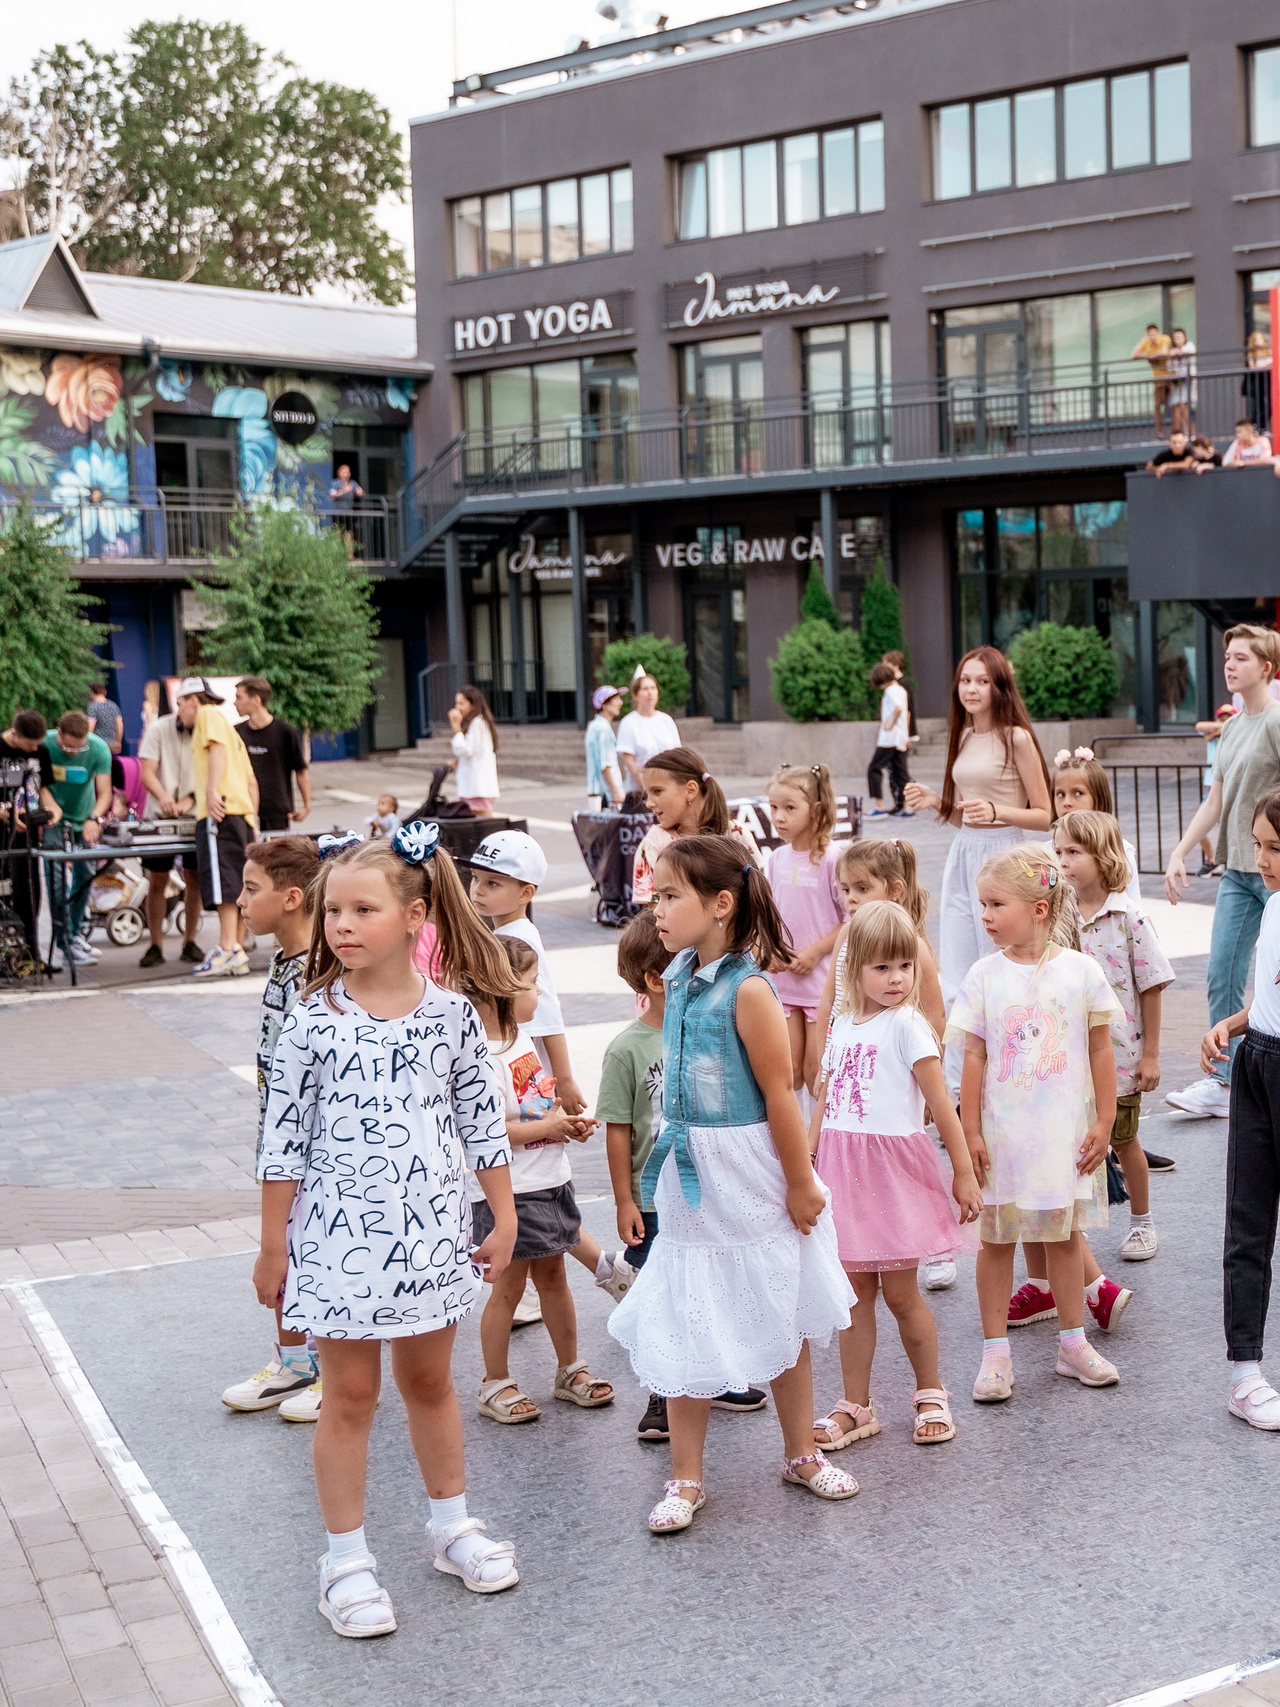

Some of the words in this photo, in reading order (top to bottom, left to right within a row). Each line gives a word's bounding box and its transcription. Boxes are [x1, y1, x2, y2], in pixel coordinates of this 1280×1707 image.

[726, 286, 753, 301] HOT
[755, 279, 790, 297] YOGA
[454, 312, 516, 351] HOT
[523, 298, 613, 340] YOGA
[655, 542, 704, 568] VEG
[711, 540, 727, 565] &
[733, 535, 788, 564] RAW
[791, 532, 857, 562] CAE
[1035, 1050, 1068, 1082] Cute
